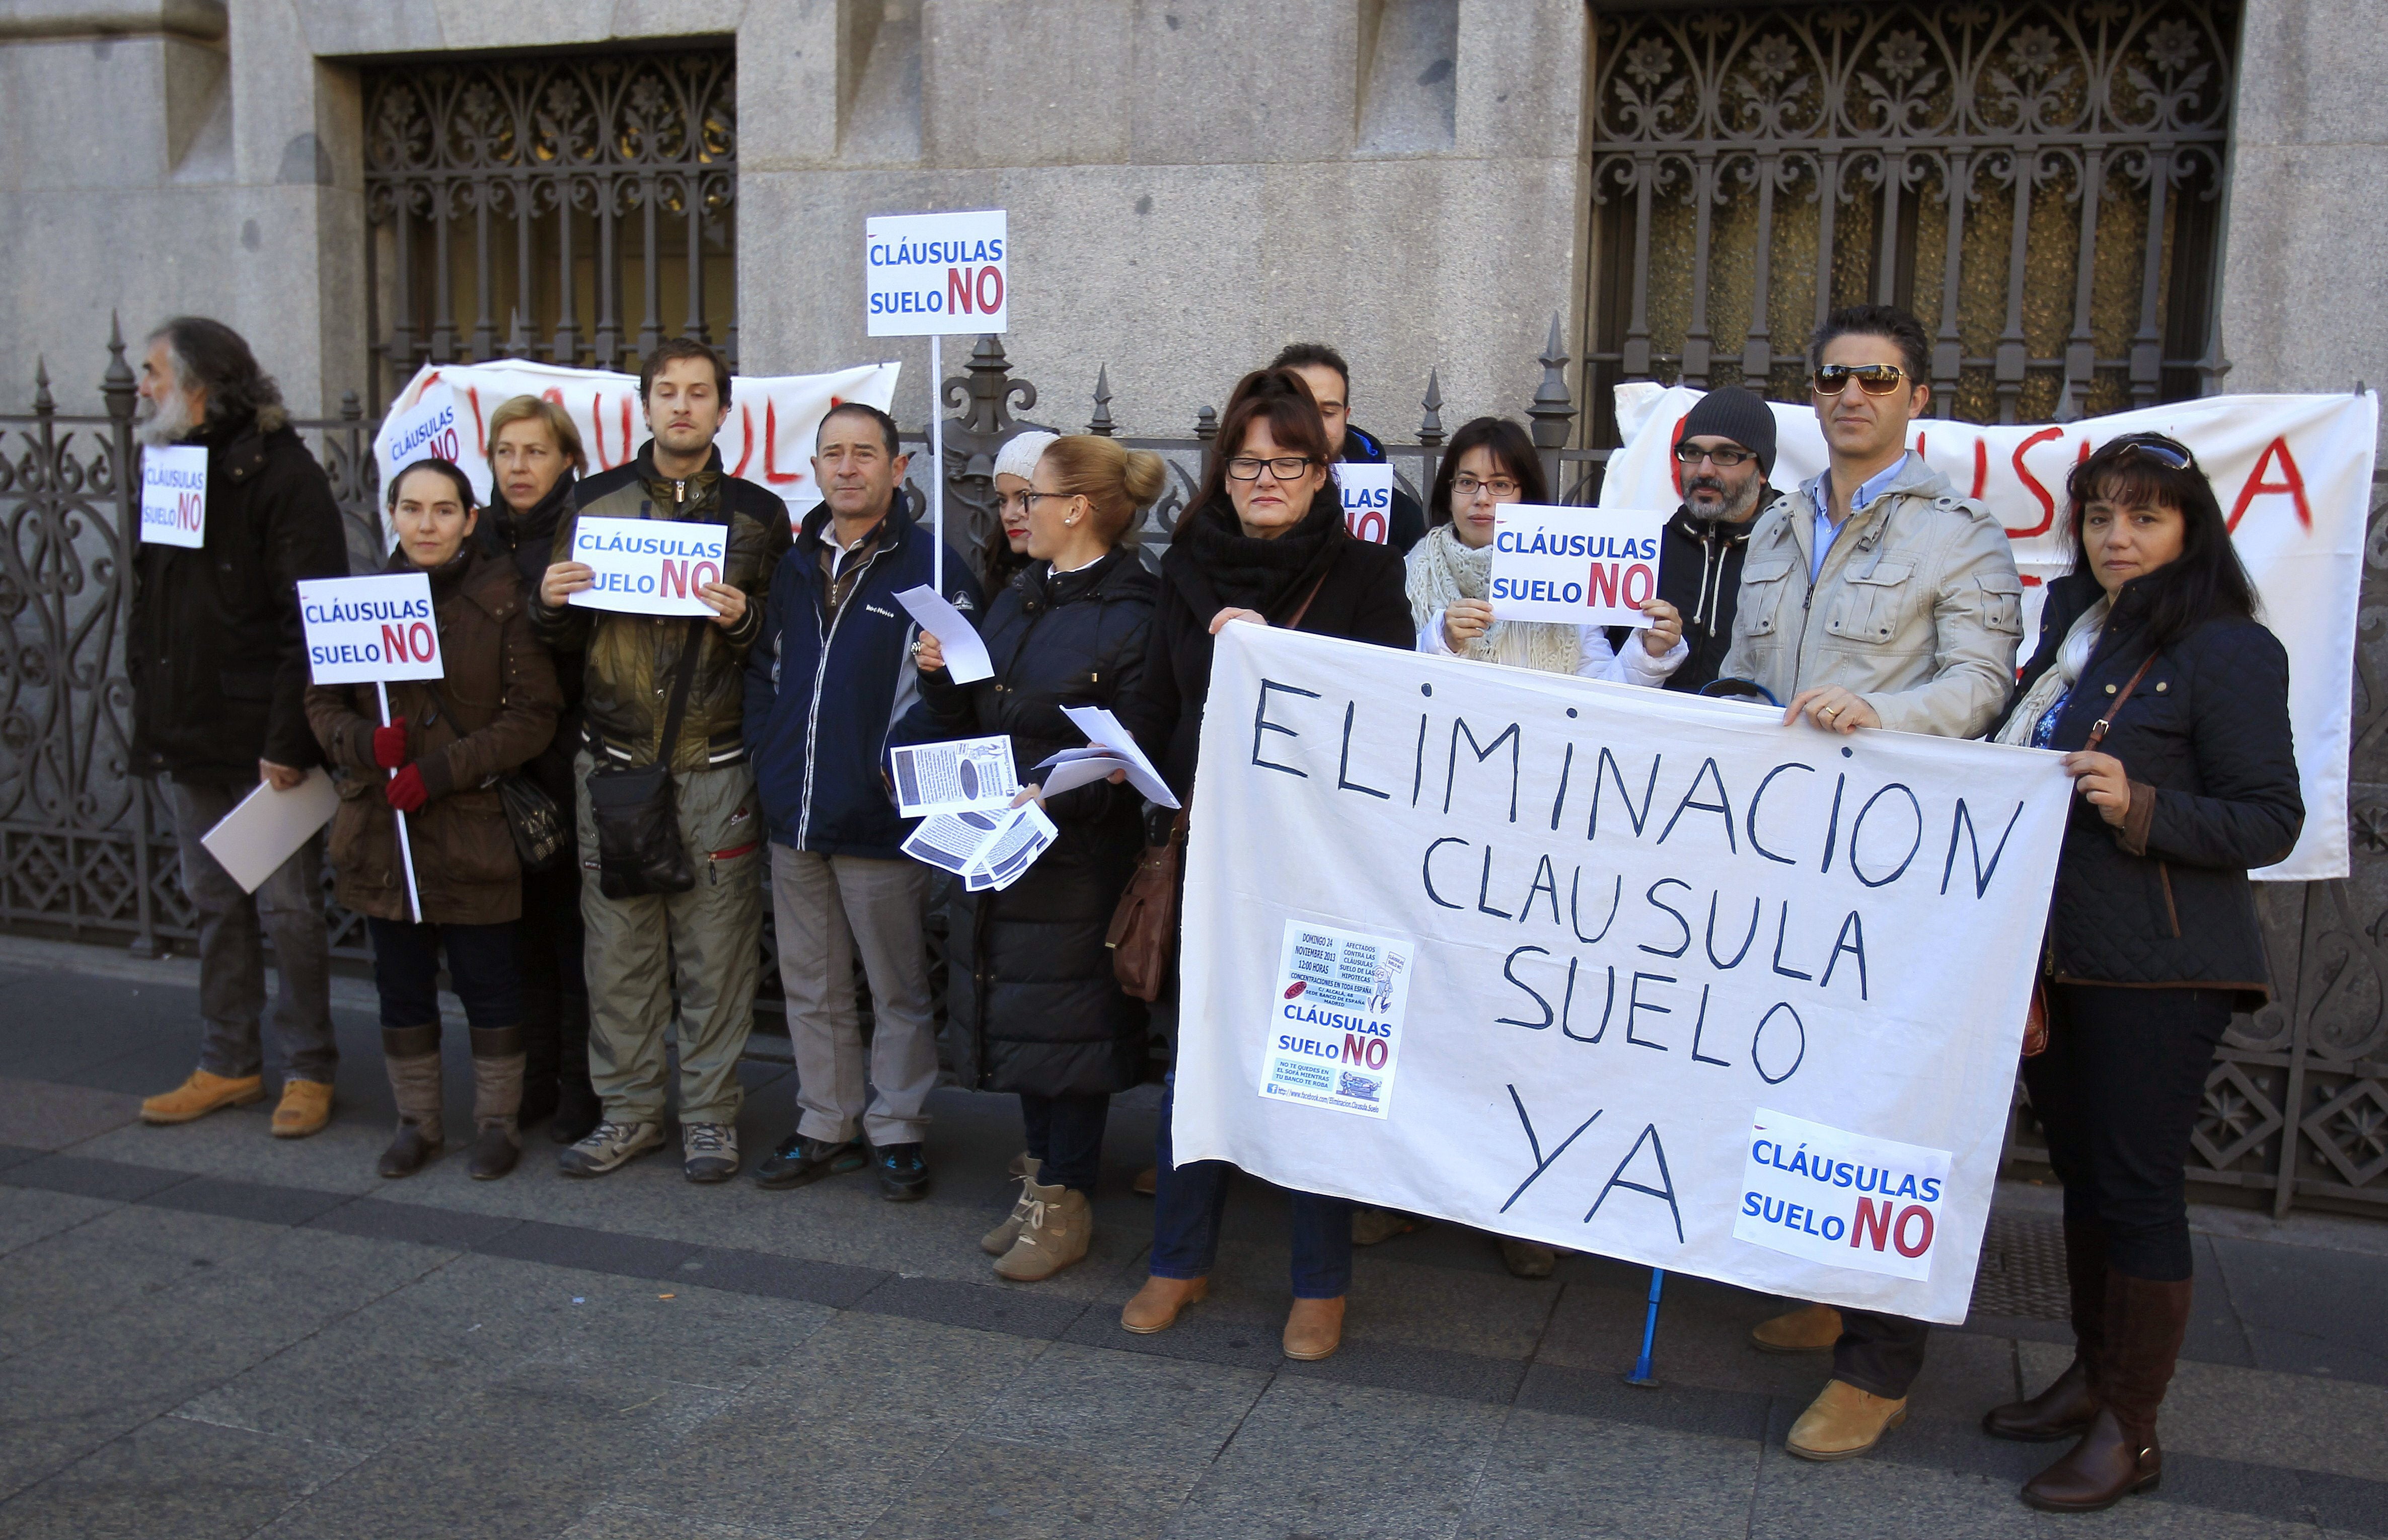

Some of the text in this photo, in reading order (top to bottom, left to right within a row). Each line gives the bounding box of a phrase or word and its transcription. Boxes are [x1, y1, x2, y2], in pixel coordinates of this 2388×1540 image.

[870, 236, 1002, 266] CLÁUSULAS
[871, 266, 1003, 315] SUELO NO
[393, 406, 454, 460] CLÁUSULAS
[431, 428, 458, 465] NO
[144, 492, 201, 531] SUELO NO
[579, 531, 722, 559] CLÁUSULAS
[1497, 526, 1657, 560] CLÁUSULAS
[592, 559, 720, 599] UELO NO
[1493, 563, 1654, 610] SUELO NO
[306, 598, 429, 623] CLÁUSULAS
[312, 622, 435, 664] SUELO NO
[1423, 837, 1867, 1000] CLAUSULA
[1295, 946, 1335, 962] NOVIEMBRE 2013
[1303, 933, 1333, 947] DOMINGO 24
[1344, 950, 1364, 958] CONTRA
[1346, 942, 1375, 952] AFECTADOS
[1299, 960, 1329, 974] 12:00 HORAS
[1339, 964, 1356, 972] SUELO
[1341, 973, 1370, 982] HIPOTECAS
[1344, 957, 1373, 967] CLÁUSULAS
[1291, 973, 1333, 986] CONCENTRACIONES
[1354, 985, 1372, 993] ESPAÑA
[1284, 1005, 1391, 1037] CLÁUSULAS
[1495, 946, 1804, 1084] SUELO
[1278, 1033, 1388, 1070] SUELO NO
[1285, 1068, 1299, 1076] SOFÁ
[1300, 1072, 1329, 1082] MIENTRAS
[1298, 1065, 1320, 1073] QUEDES
[1313, 1081, 1328, 1089] ROBA
[1500, 1084, 1684, 1243] YA
[1752, 1143, 1942, 1202] CLÁUSULAS
[1742, 1192, 1933, 1258] SUELO NO
